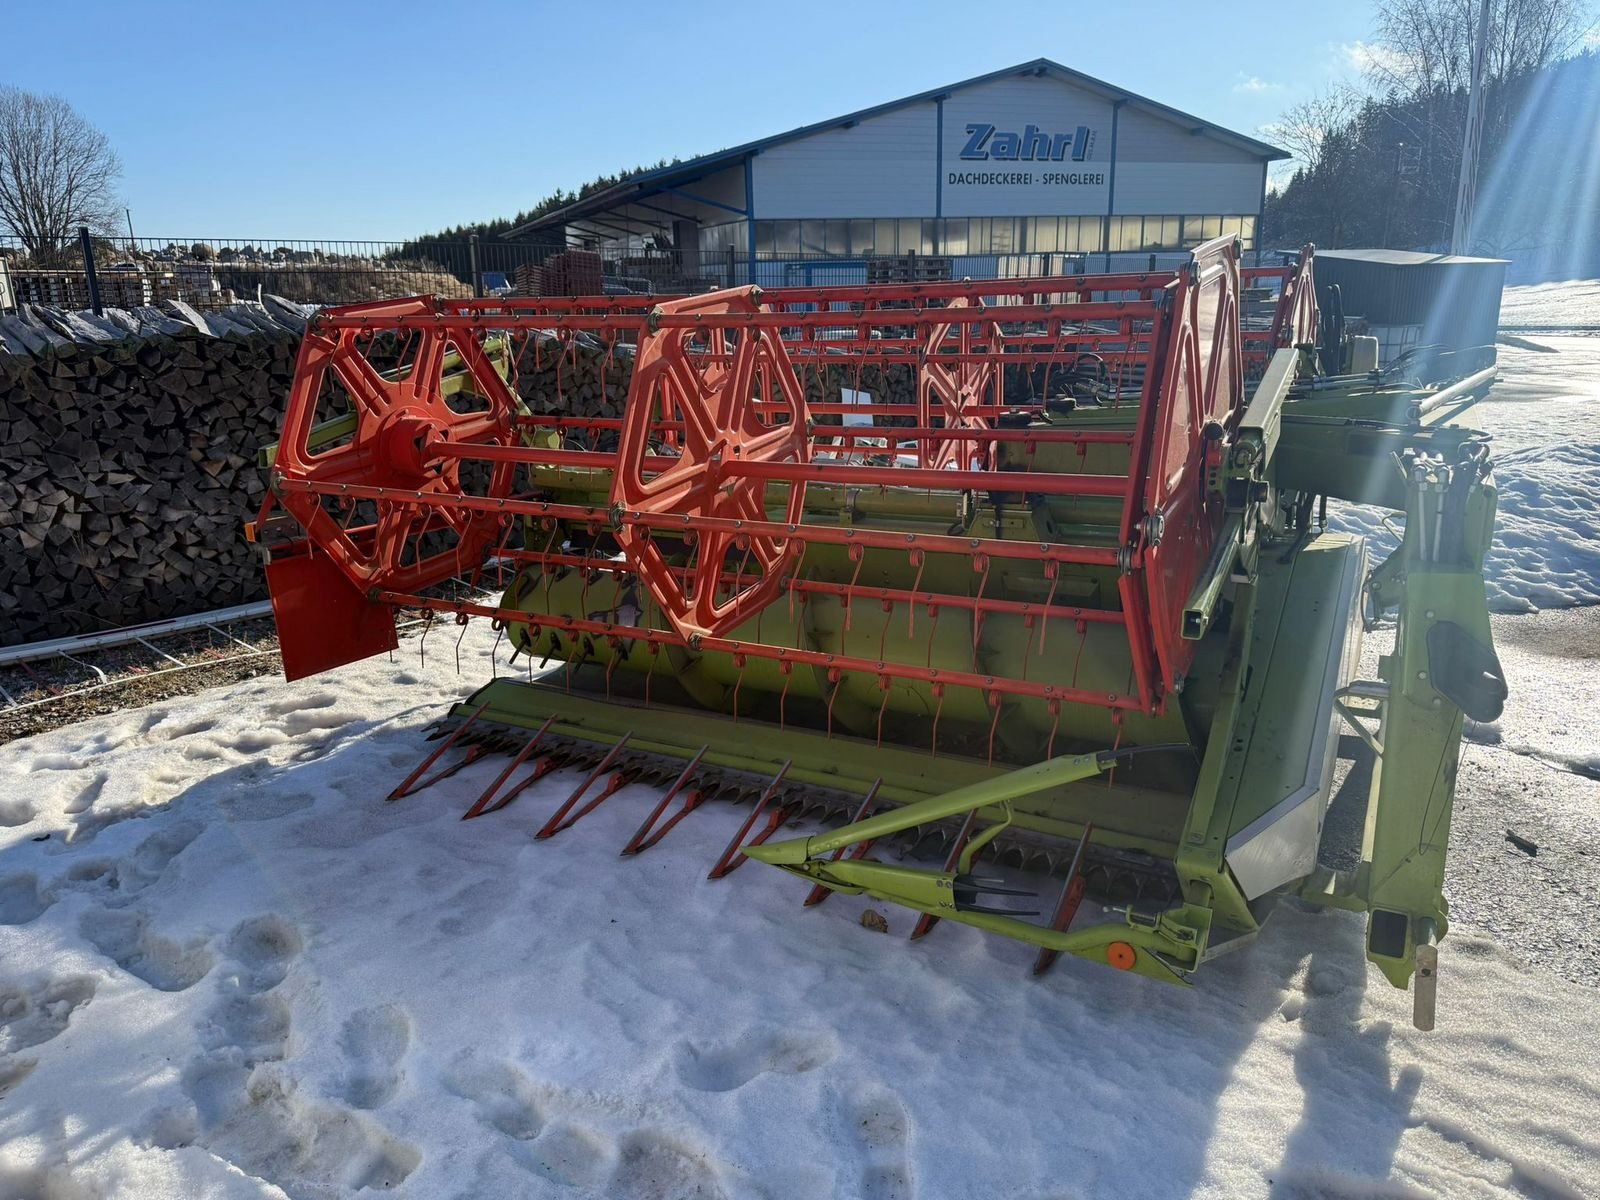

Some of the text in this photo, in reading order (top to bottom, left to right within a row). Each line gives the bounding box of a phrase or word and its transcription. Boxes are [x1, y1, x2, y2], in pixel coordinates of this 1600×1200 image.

[959, 124, 1090, 161] Zahrl
[948, 173, 1032, 185] DACHDECKEREI
[1042, 173, 1104, 185] SPENGLEREI
